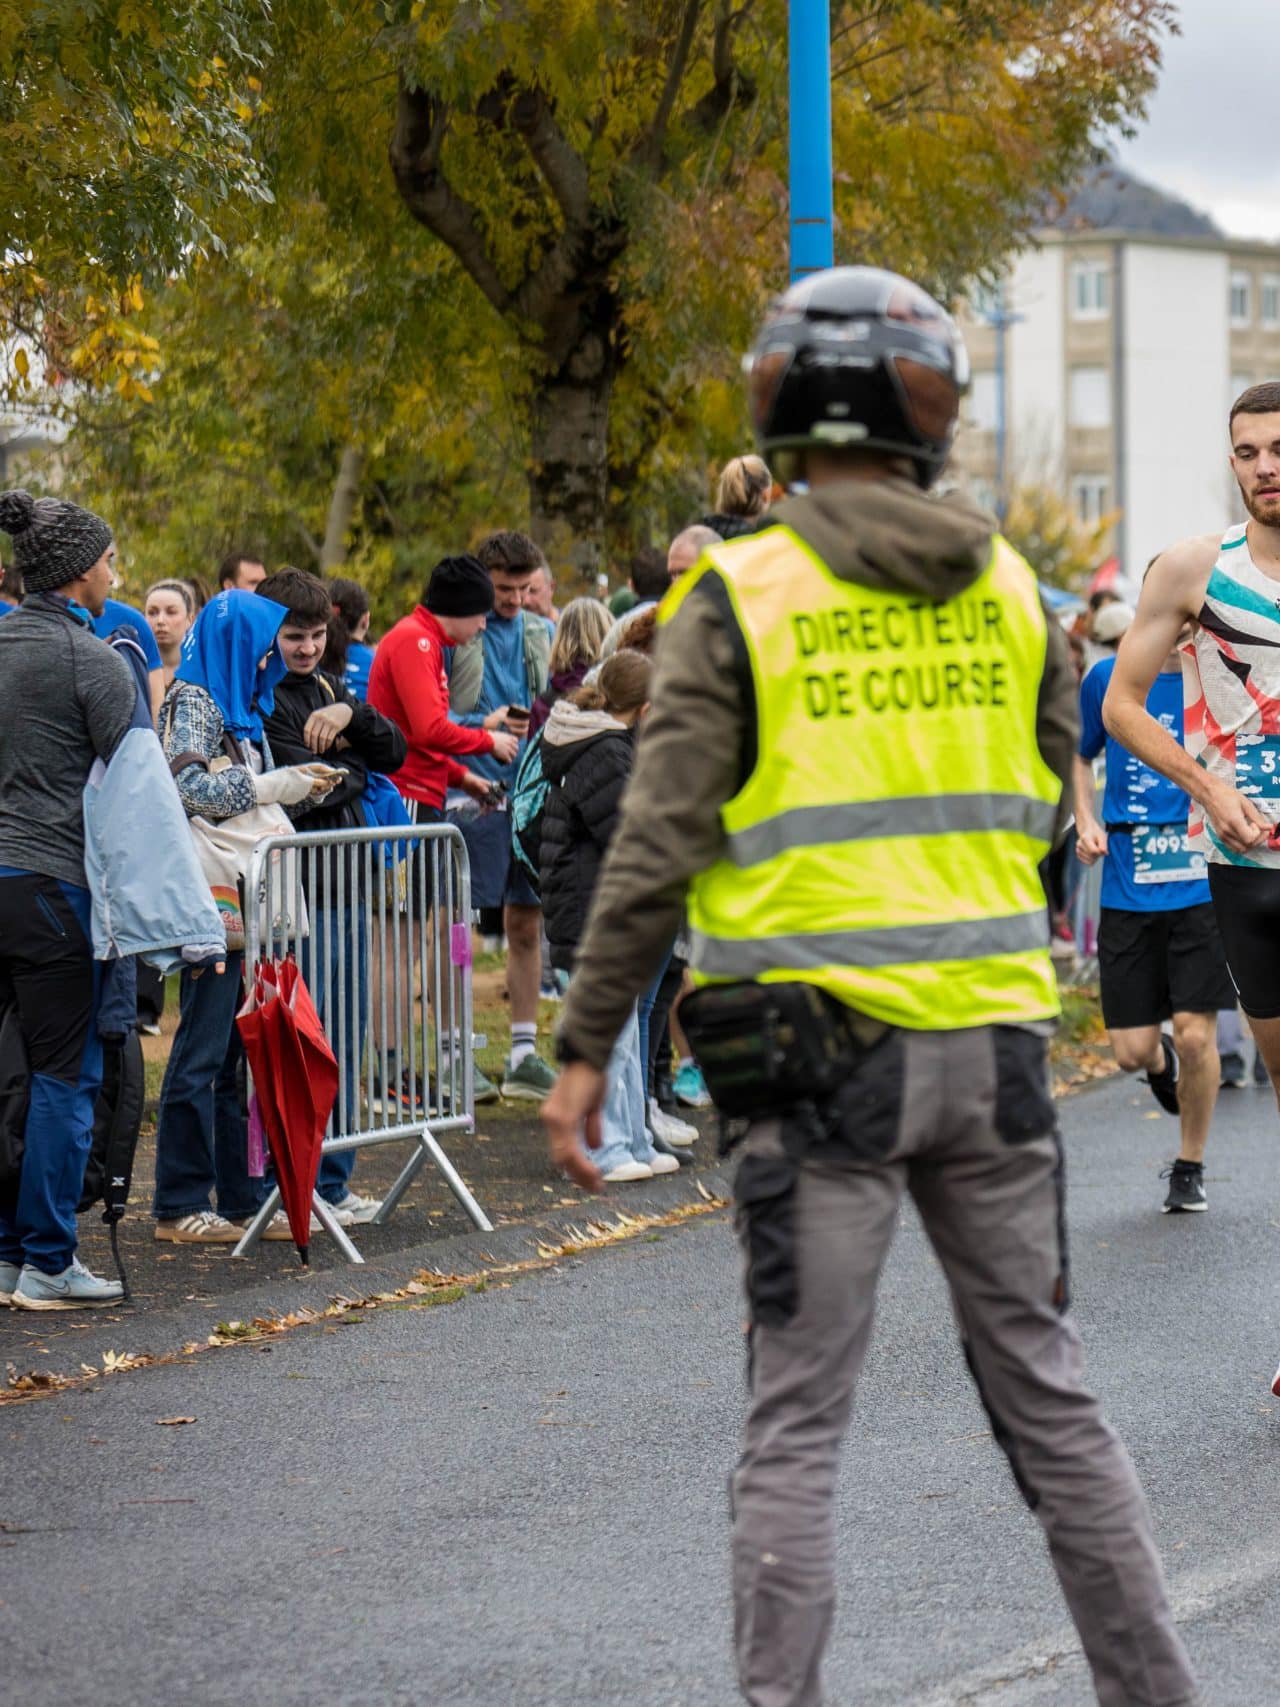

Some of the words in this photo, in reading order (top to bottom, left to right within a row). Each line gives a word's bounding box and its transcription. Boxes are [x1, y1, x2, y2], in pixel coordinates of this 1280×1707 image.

[793, 599, 1003, 657] DIRECTEUR
[804, 671, 853, 718] DE
[863, 661, 1008, 712] COURSE
